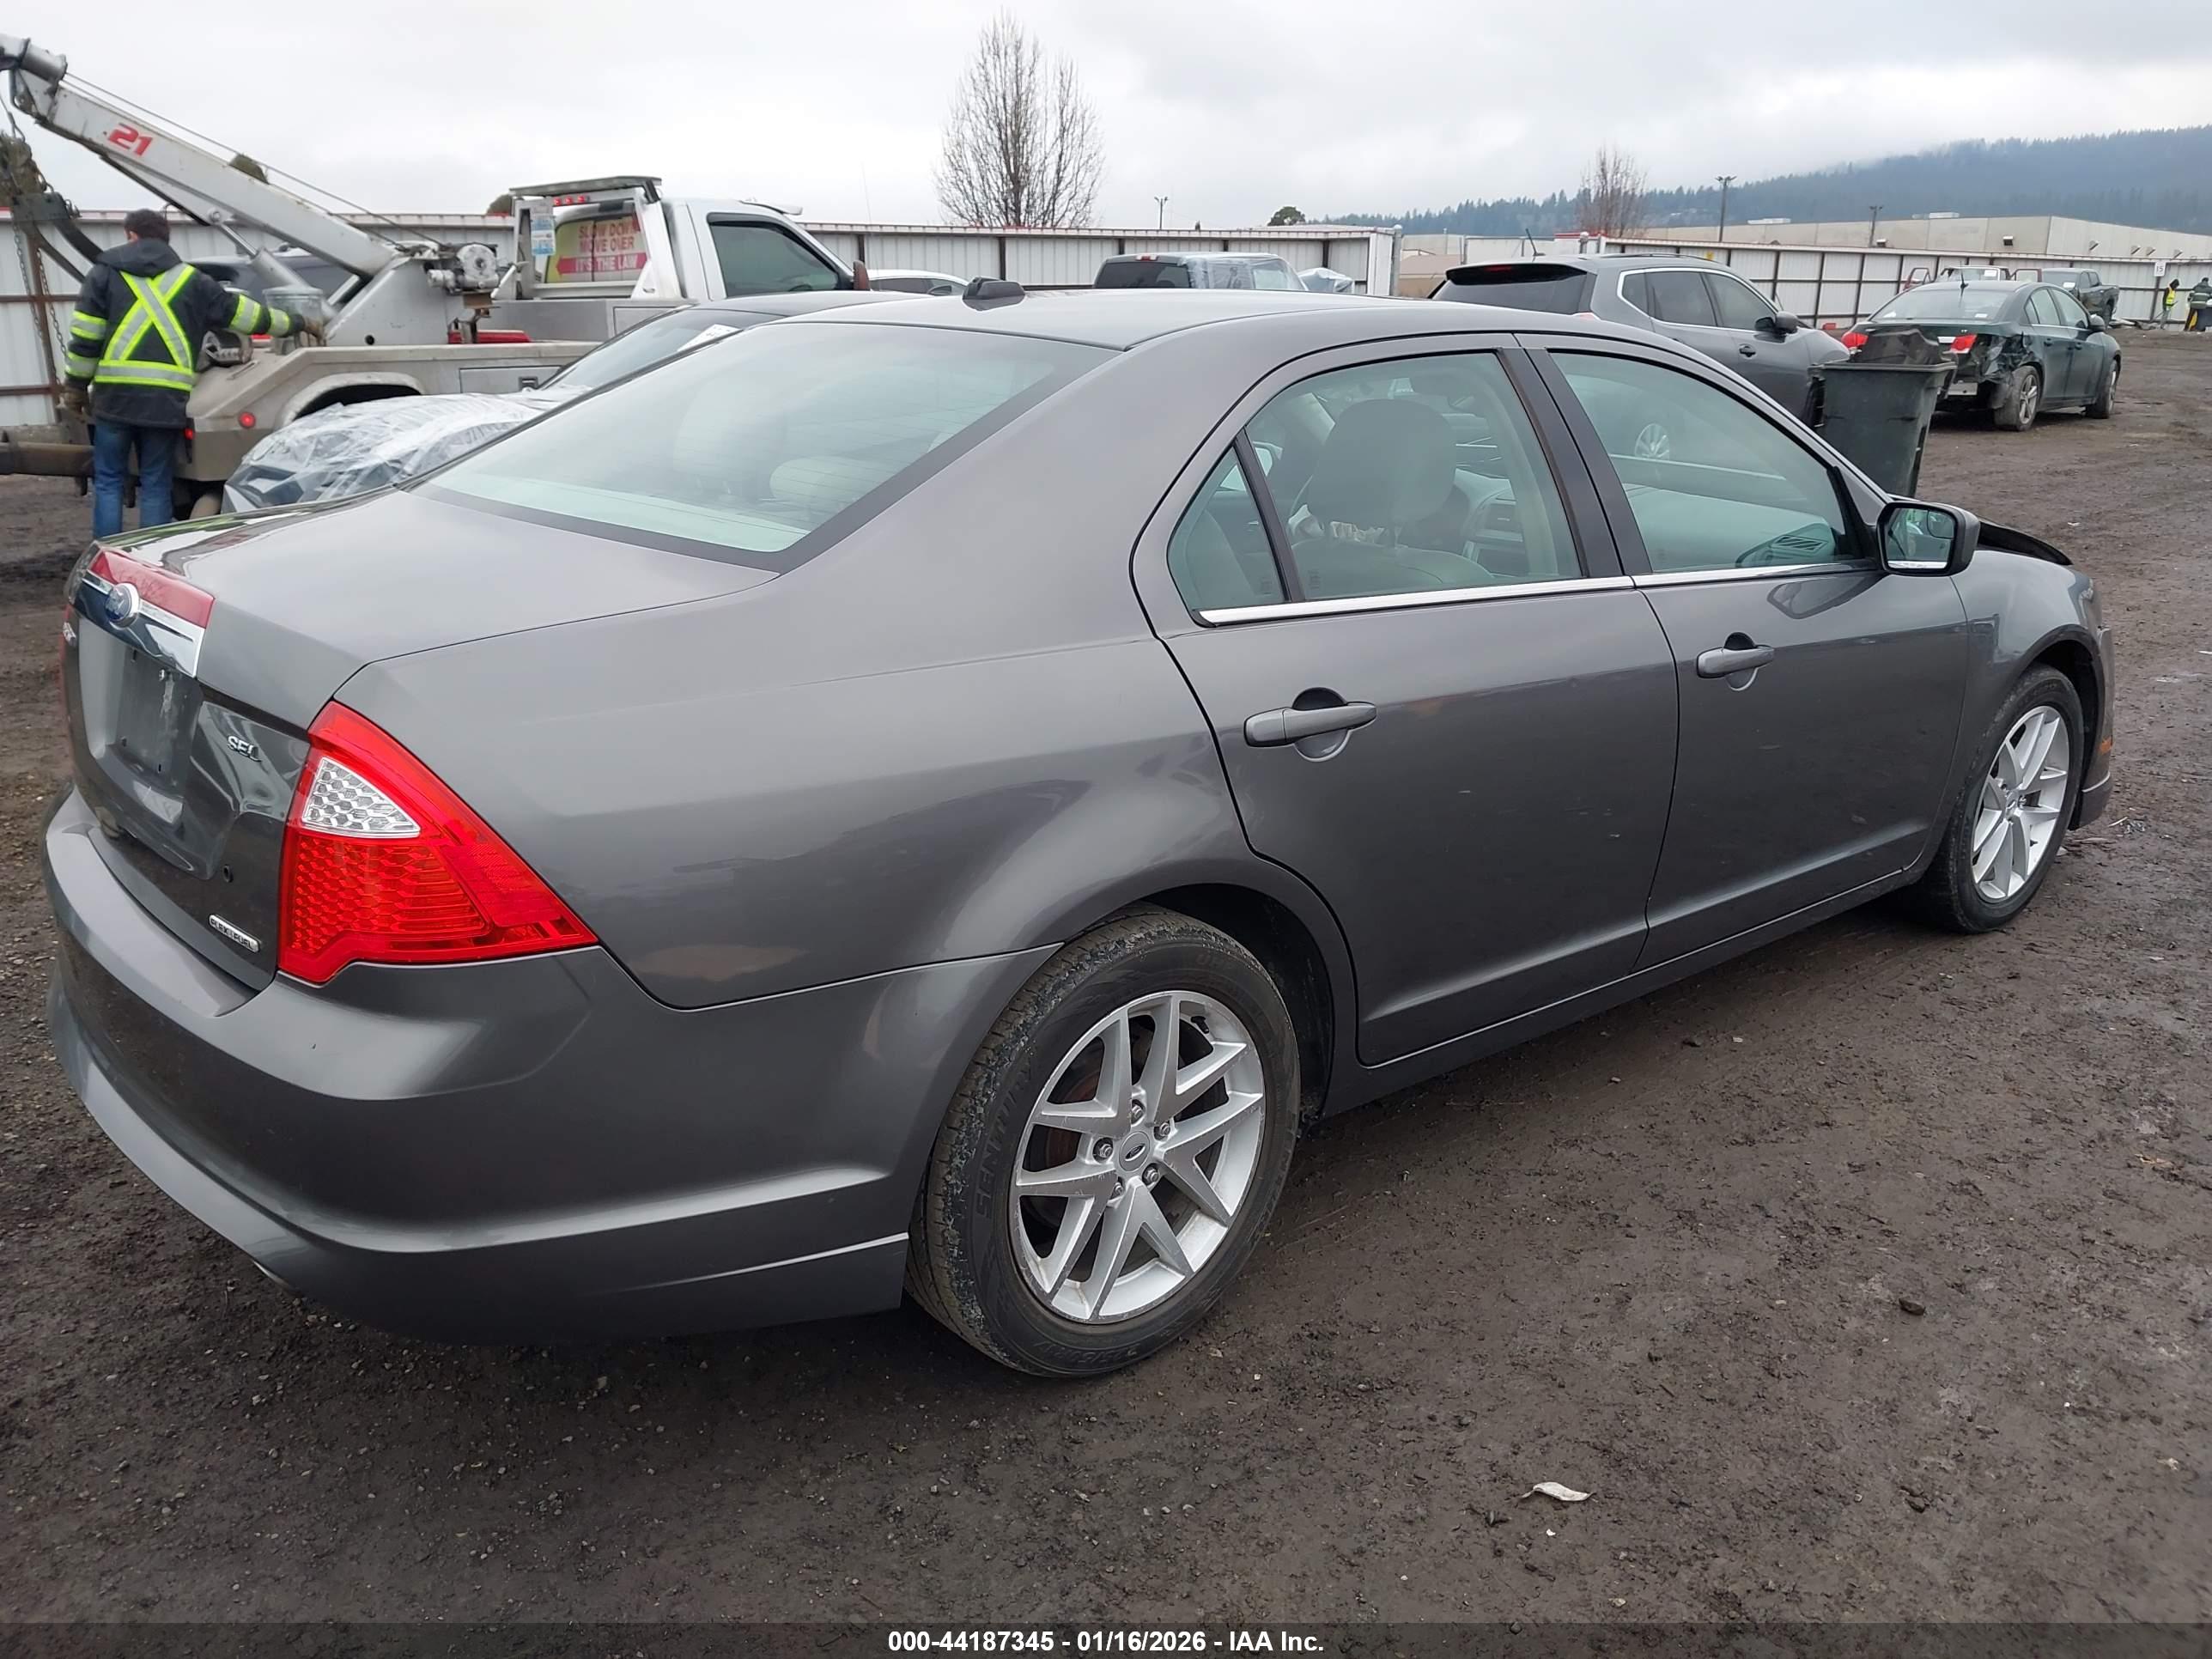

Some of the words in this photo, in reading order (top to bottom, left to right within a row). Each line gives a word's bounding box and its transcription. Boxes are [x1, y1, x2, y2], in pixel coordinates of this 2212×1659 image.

[108, 123, 153, 156] 21
[578, 222, 606, 239] SLOW
[597, 256, 616, 270] THE
[617, 254, 637, 270] LAW
